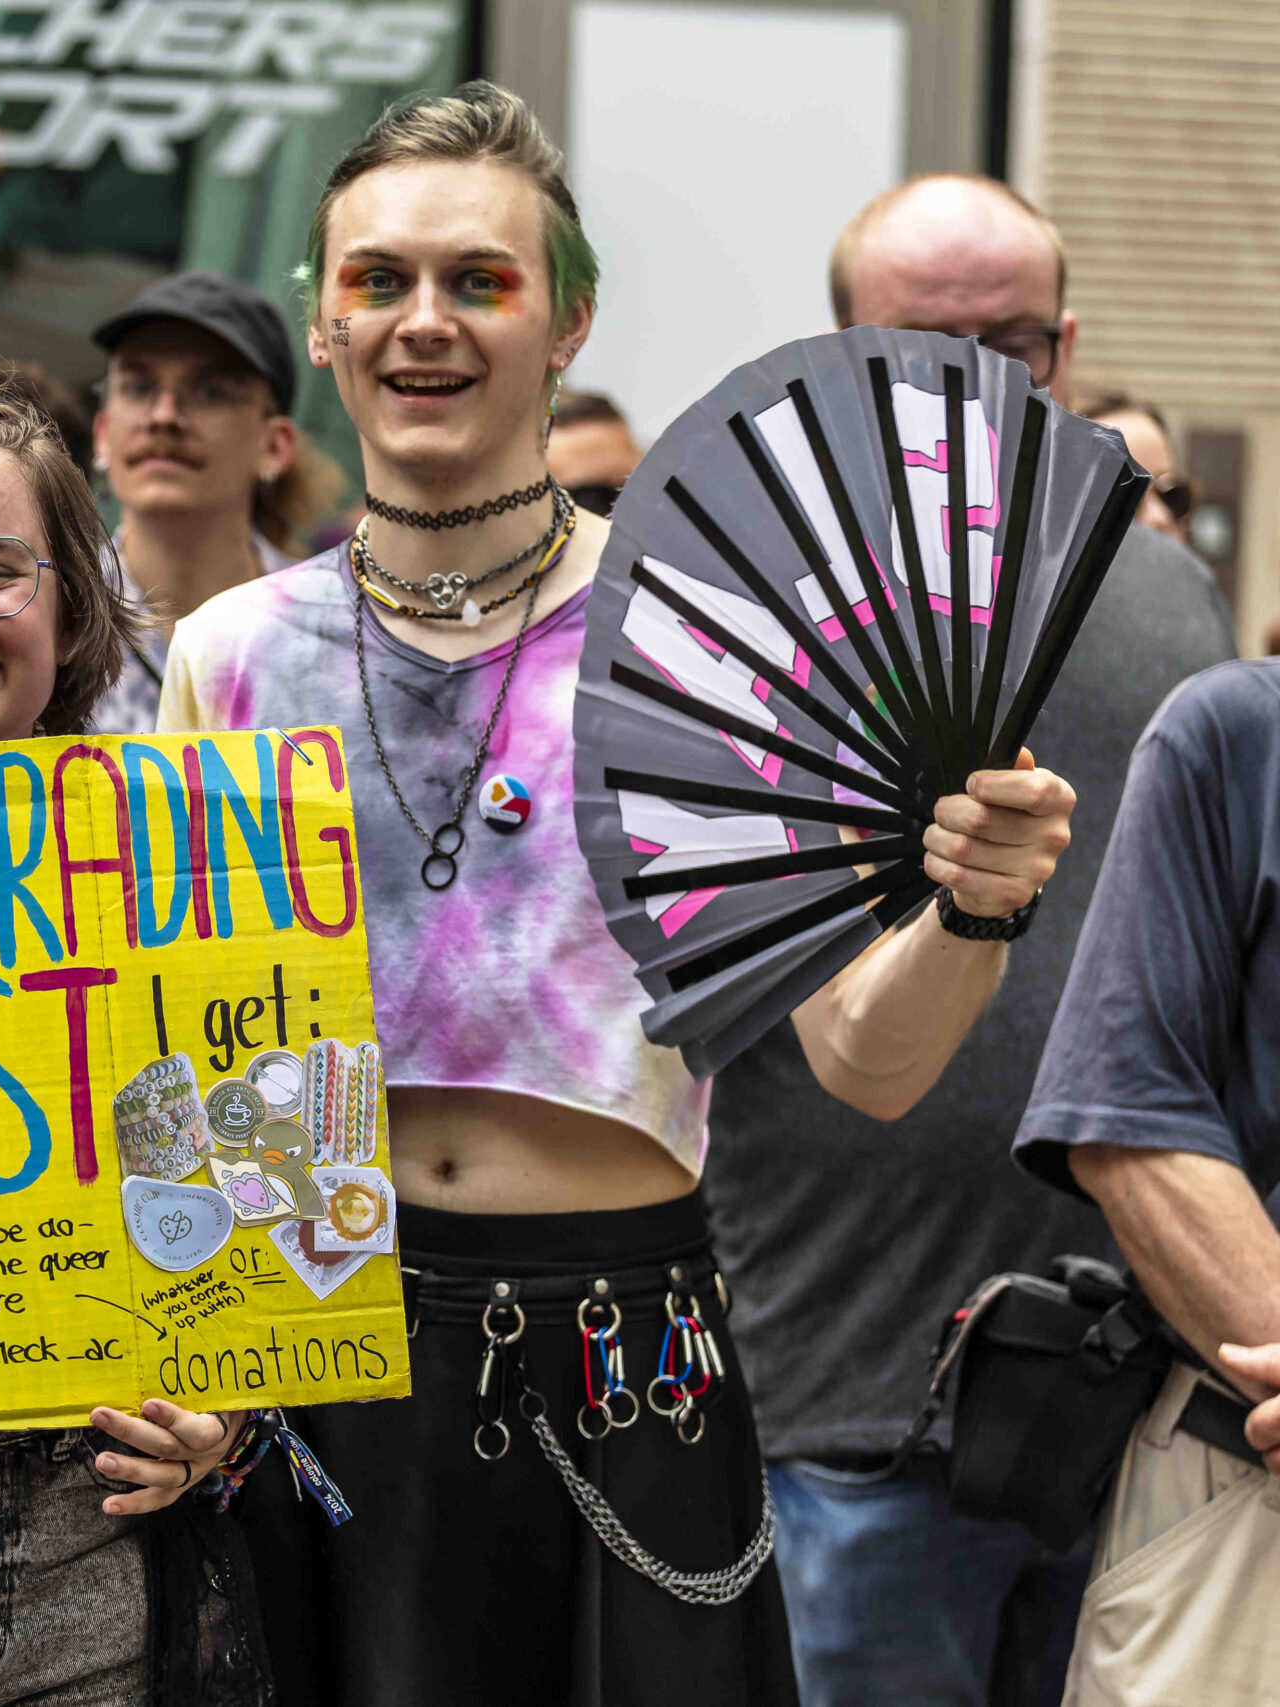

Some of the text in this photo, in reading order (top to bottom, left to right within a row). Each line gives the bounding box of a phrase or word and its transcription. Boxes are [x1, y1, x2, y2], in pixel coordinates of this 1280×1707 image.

[152, 964, 322, 1072] I get:
[122, 1075, 176, 1100] SWEET
[144, 1135, 194, 1161] HAPPY
[154, 1147, 195, 1171] LOVE
[161, 1156, 200, 1181] HOPE
[39, 1250, 110, 1281] queer
[162, 1280, 231, 1319] you come
[175, 1286, 246, 1330] up with)
[159, 1326, 388, 1396] donations
[300, 1457, 322, 1487] cologne
[324, 1493, 343, 1514] 2024
